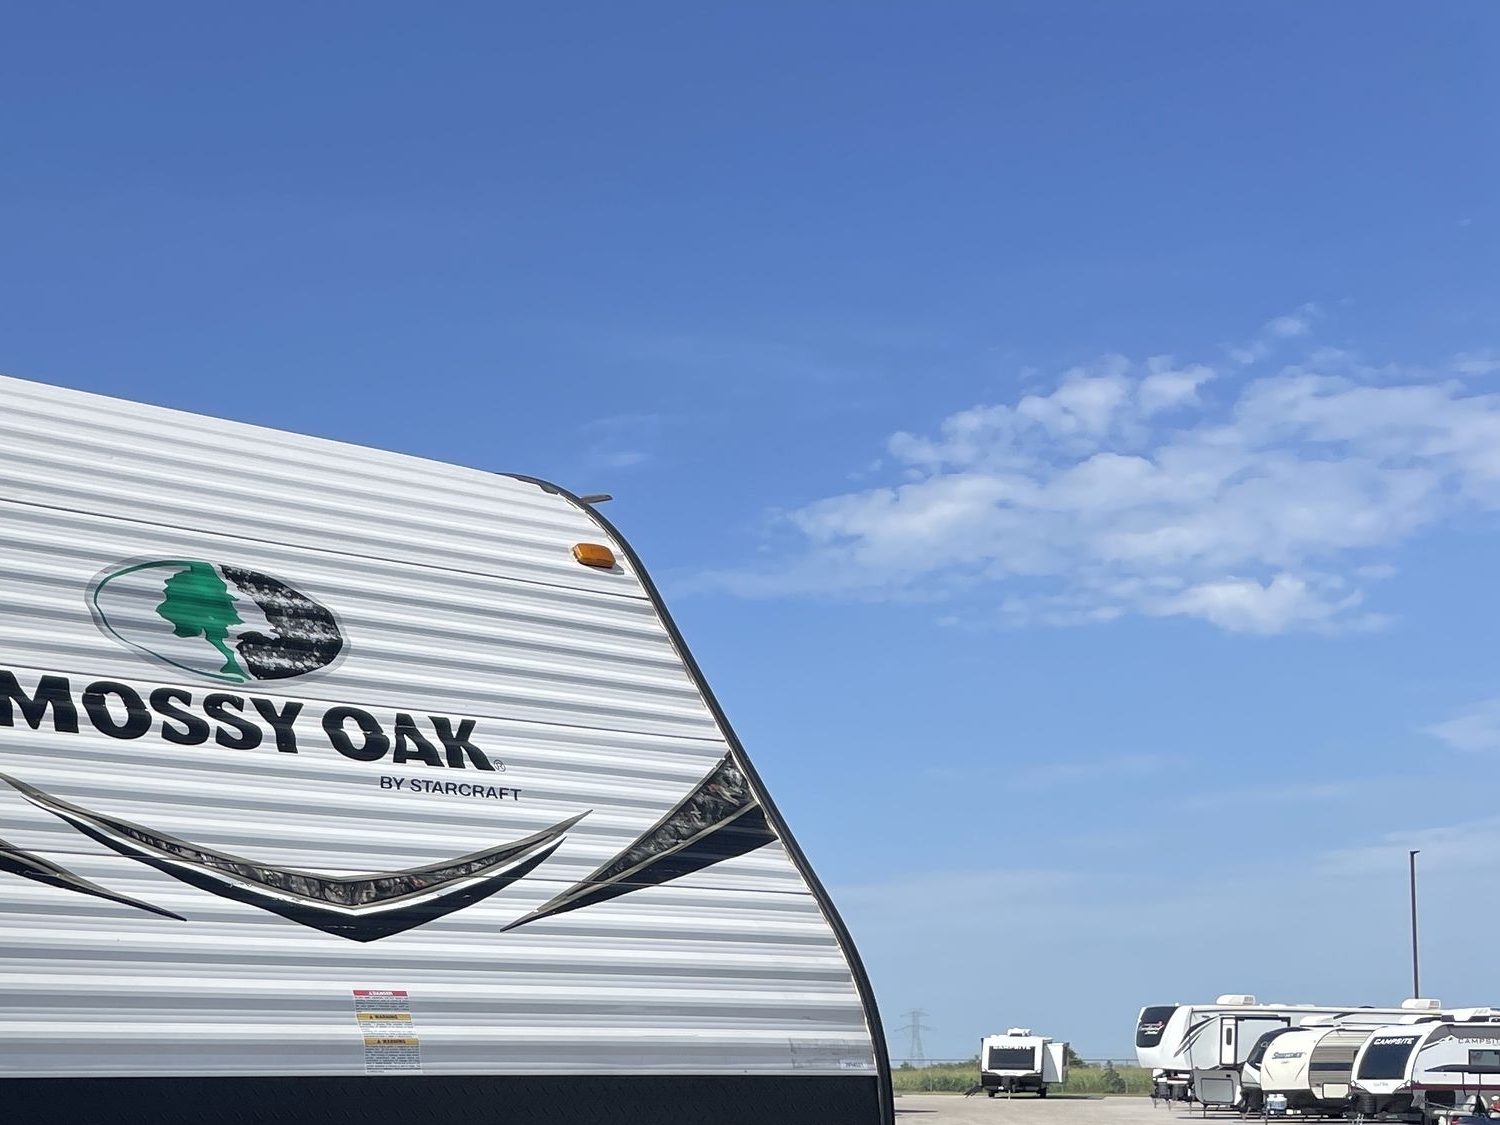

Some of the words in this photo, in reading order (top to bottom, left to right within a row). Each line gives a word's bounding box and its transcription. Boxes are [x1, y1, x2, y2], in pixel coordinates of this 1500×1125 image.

[321, 705, 497, 771] OAK
[380, 775, 405, 790] BY
[410, 778, 522, 801] STARCRAFT
[1373, 1037, 1415, 1045] CAMPSITE
